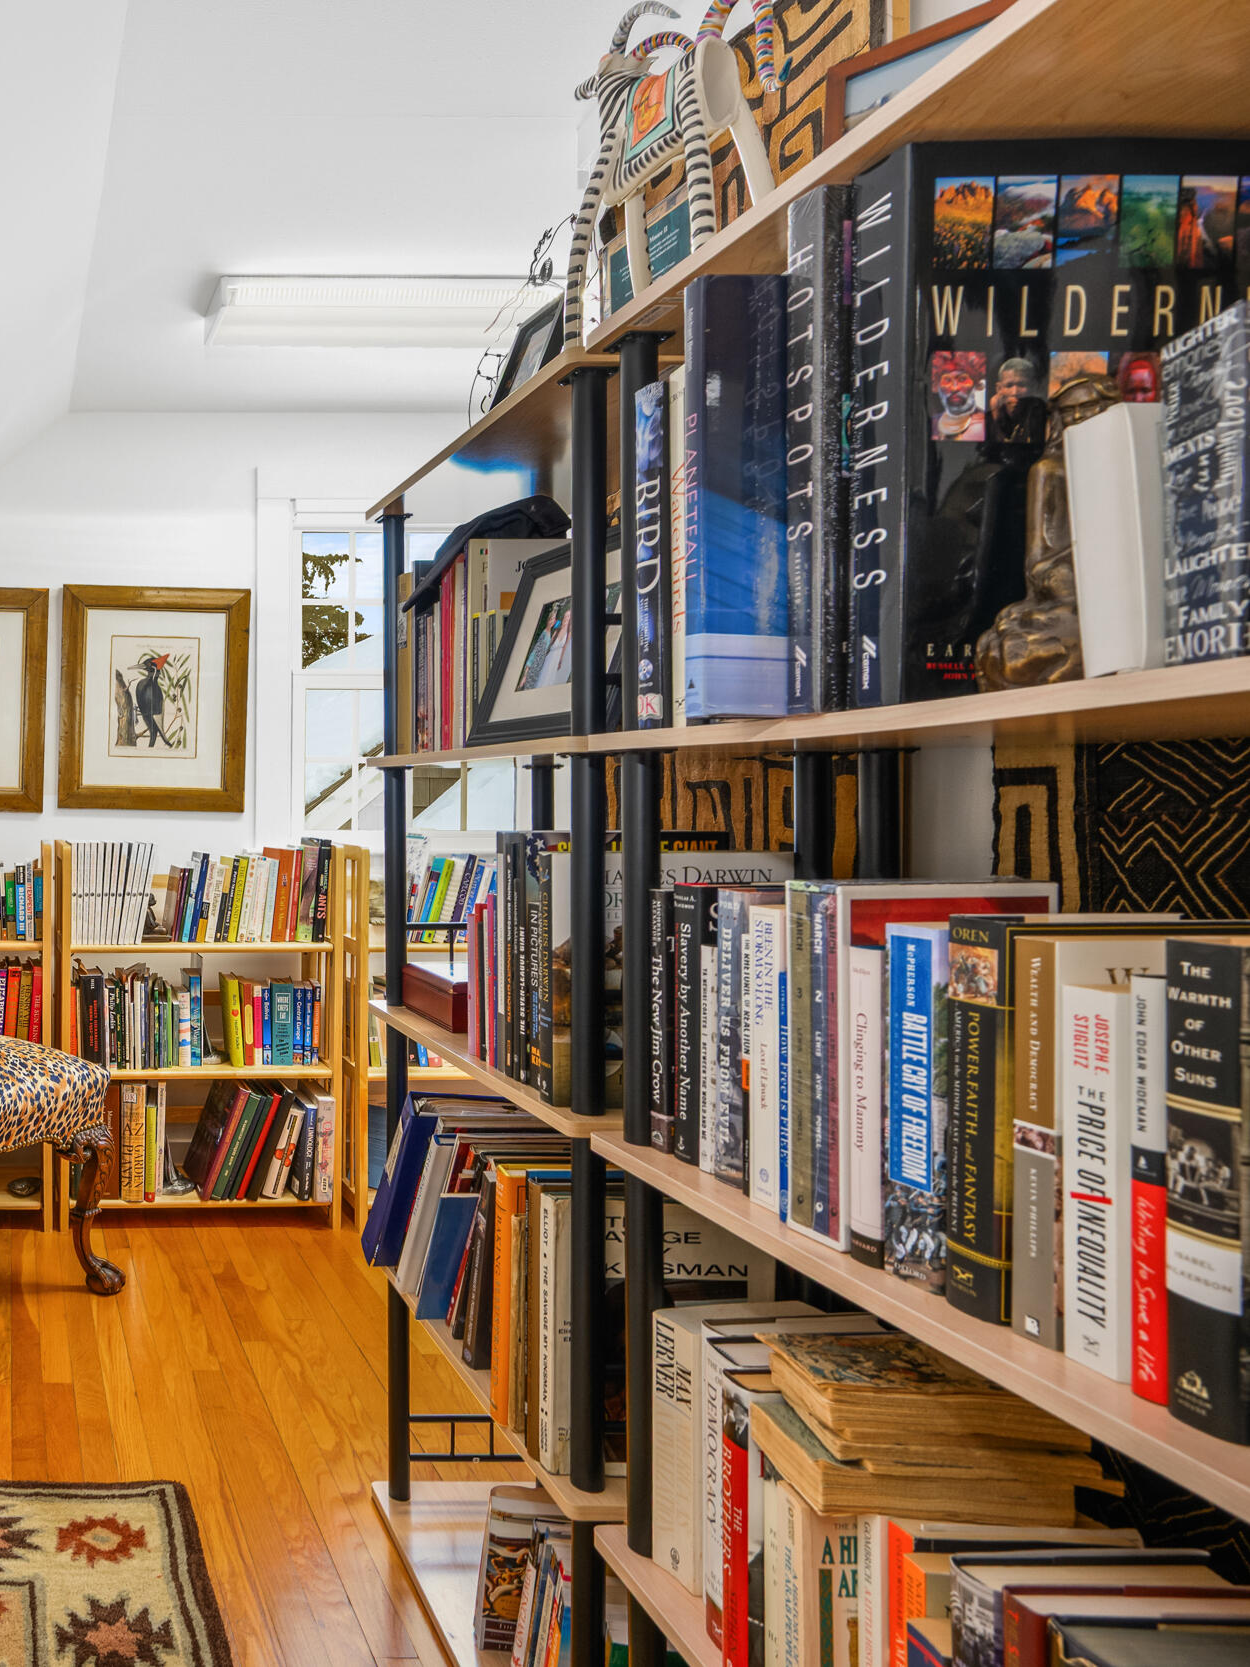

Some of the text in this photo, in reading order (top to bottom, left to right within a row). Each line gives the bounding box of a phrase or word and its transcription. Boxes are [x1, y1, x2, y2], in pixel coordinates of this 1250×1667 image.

[931, 284, 1250, 339] WILDERN
[786, 243, 814, 543] HOTSPOTS
[854, 192, 892, 592] WILDERNESS
[685, 412, 699, 580] PLANETFALL
[635, 476, 661, 595] BIRD
[670, 462, 686, 635] Waterbirds
[1177, 598, 1250, 630] FAMILY
[673, 840, 719, 851] GIANT
[681, 865, 773, 884] DARWIN
[18, 886, 26, 921] RICHARD
[316, 893, 326, 919] ANTS
[827, 913, 837, 954] MARCH
[952, 926, 990, 943] OREN
[530, 911, 540, 987] IN PICTURES
[540, 891, 550, 1003] CHARLES DARWIN
[753, 919, 764, 1026] STORM LONG
[763, 921, 773, 1010] BEEN THE
[813, 912, 823, 1002] MARCH 2
[906, 943, 917, 1007] McPHERSON
[1179, 959, 1212, 980] THE
[31, 994, 42, 1044] THE SUN KING
[519, 957, 527, 1018] SEVEN-LEAGUE
[1167, 984, 1233, 1010] WARMTH
[651, 954, 664, 1105] The New Jim Crow
[678, 922, 692, 1121] Slavery by Another Name
[719, 927, 733, 1146] DELIVER US FROM EVIL
[1028, 956, 1042, 1112] WEALTH AND DEMOCRACY
[1072, 1012, 1090, 1070] STIGLITZ
[1094, 1012, 1110, 1076] JOSEPH E.
[1170, 1039, 1223, 1064] OTHER
[1184, 1016, 1206, 1034] OF
[779, 1024, 789, 1094] How Free
[814, 1031, 823, 1150] LEWIS AYDIN POWELL
[852, 1011, 869, 1153] Clinging to Mammy
[1136, 994, 1148, 1133] JOHN EDGAR WIDEMAN
[1174, 1066, 1218, 1090] SUNS
[900, 1011, 928, 1183] BATTLE CRY OF FREEDOM
[1077, 1084, 1106, 1102] THE
[122, 1144, 133, 1189] PLANTS
[134, 1144, 144, 1189] GARDEN
[306, 1127, 315, 1158] LIMNOLOGY
[963, 1161, 978, 1243] FANTASY
[1029, 1167, 1038, 1258] KEVIN PHILLIPS
[1076, 1099, 1106, 1329] PRICE OF INEQUALITY
[494, 1214, 503, 1275] BAKING
[1133, 1196, 1154, 1324] Writing Save
[1174, 1251, 1216, 1274] ISABEL
[543, 1334, 549, 1350] MY
[655, 1319, 675, 1403] LERNER
[675, 1360, 692, 1411] MAX
[706, 1380, 720, 1534] DEMOCRACY
[721, 1444, 733, 1576] BROTHERS
[733, 1506, 742, 1534] THE
[822, 1536, 835, 1564] A
[863, 1521, 872, 1584] GOMBRICH
